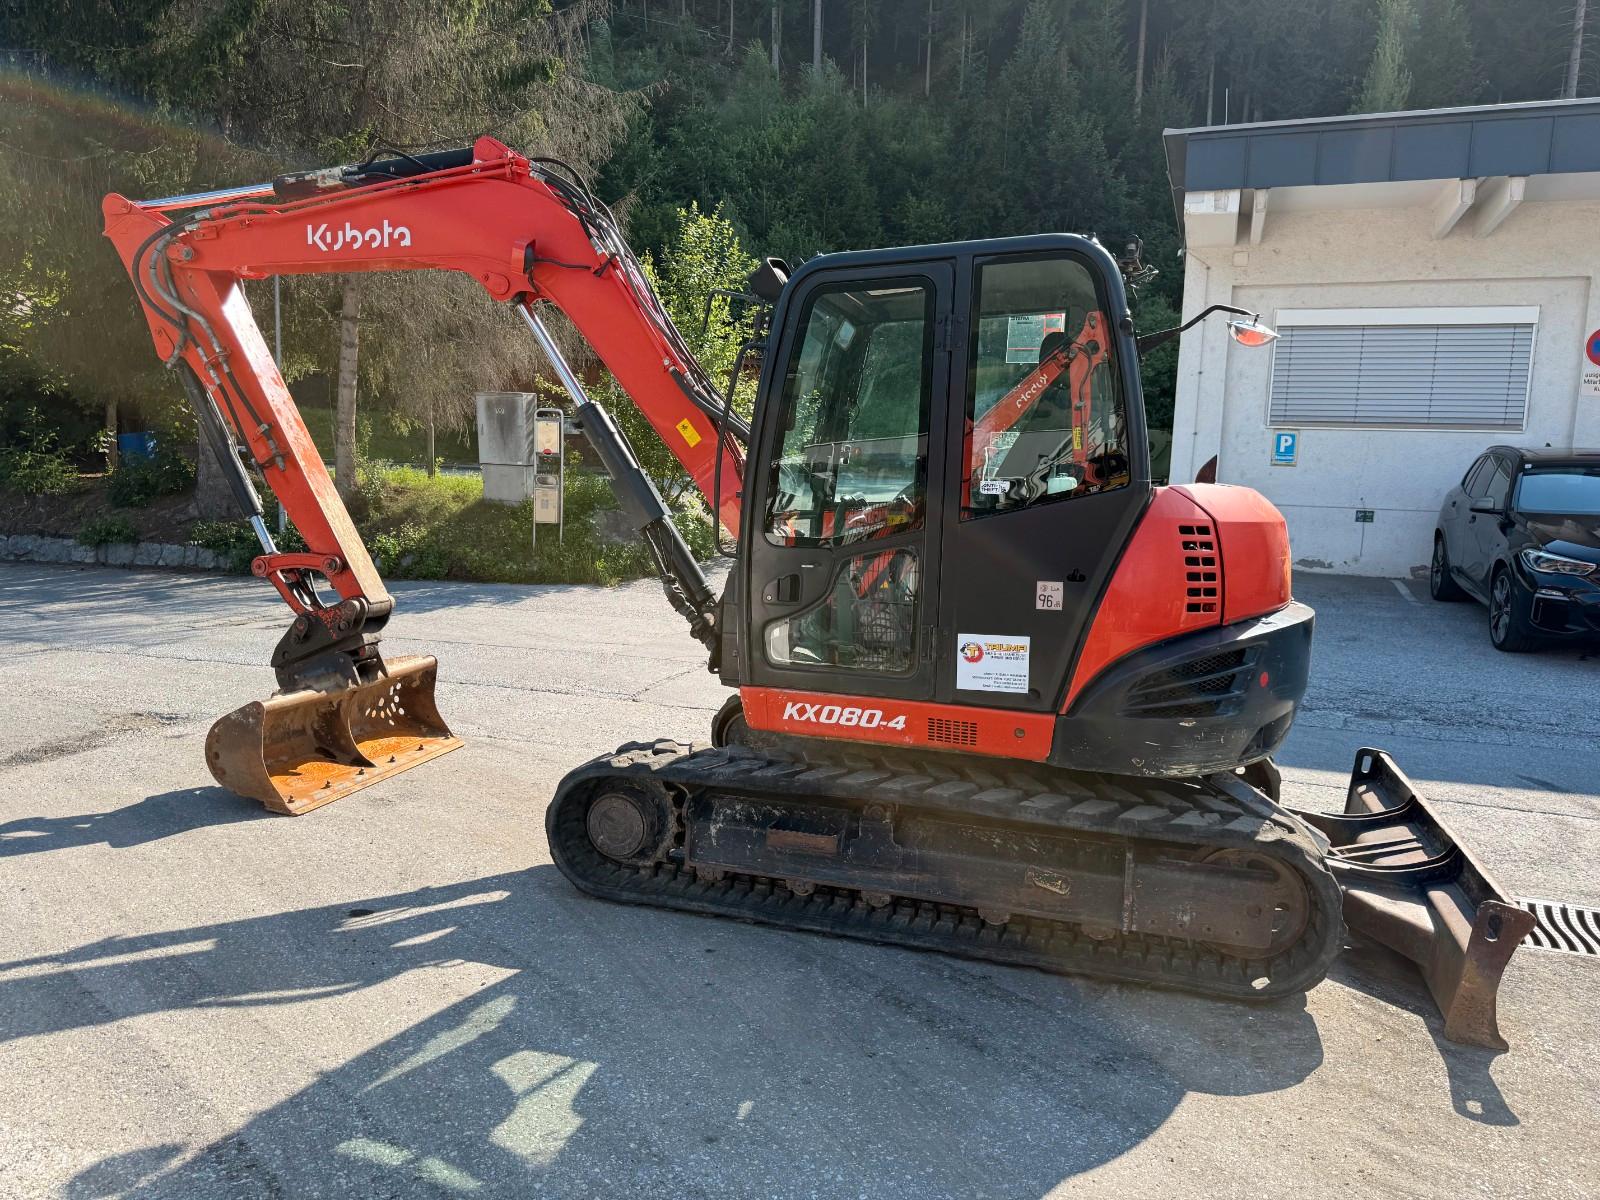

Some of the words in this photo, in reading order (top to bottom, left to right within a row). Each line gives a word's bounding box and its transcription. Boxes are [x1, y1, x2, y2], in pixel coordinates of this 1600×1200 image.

[307, 219, 411, 252] Kubota
[1280, 436, 1293, 453] P
[1038, 593, 1054, 608] 96
[782, 701, 906, 731] KX080-4
